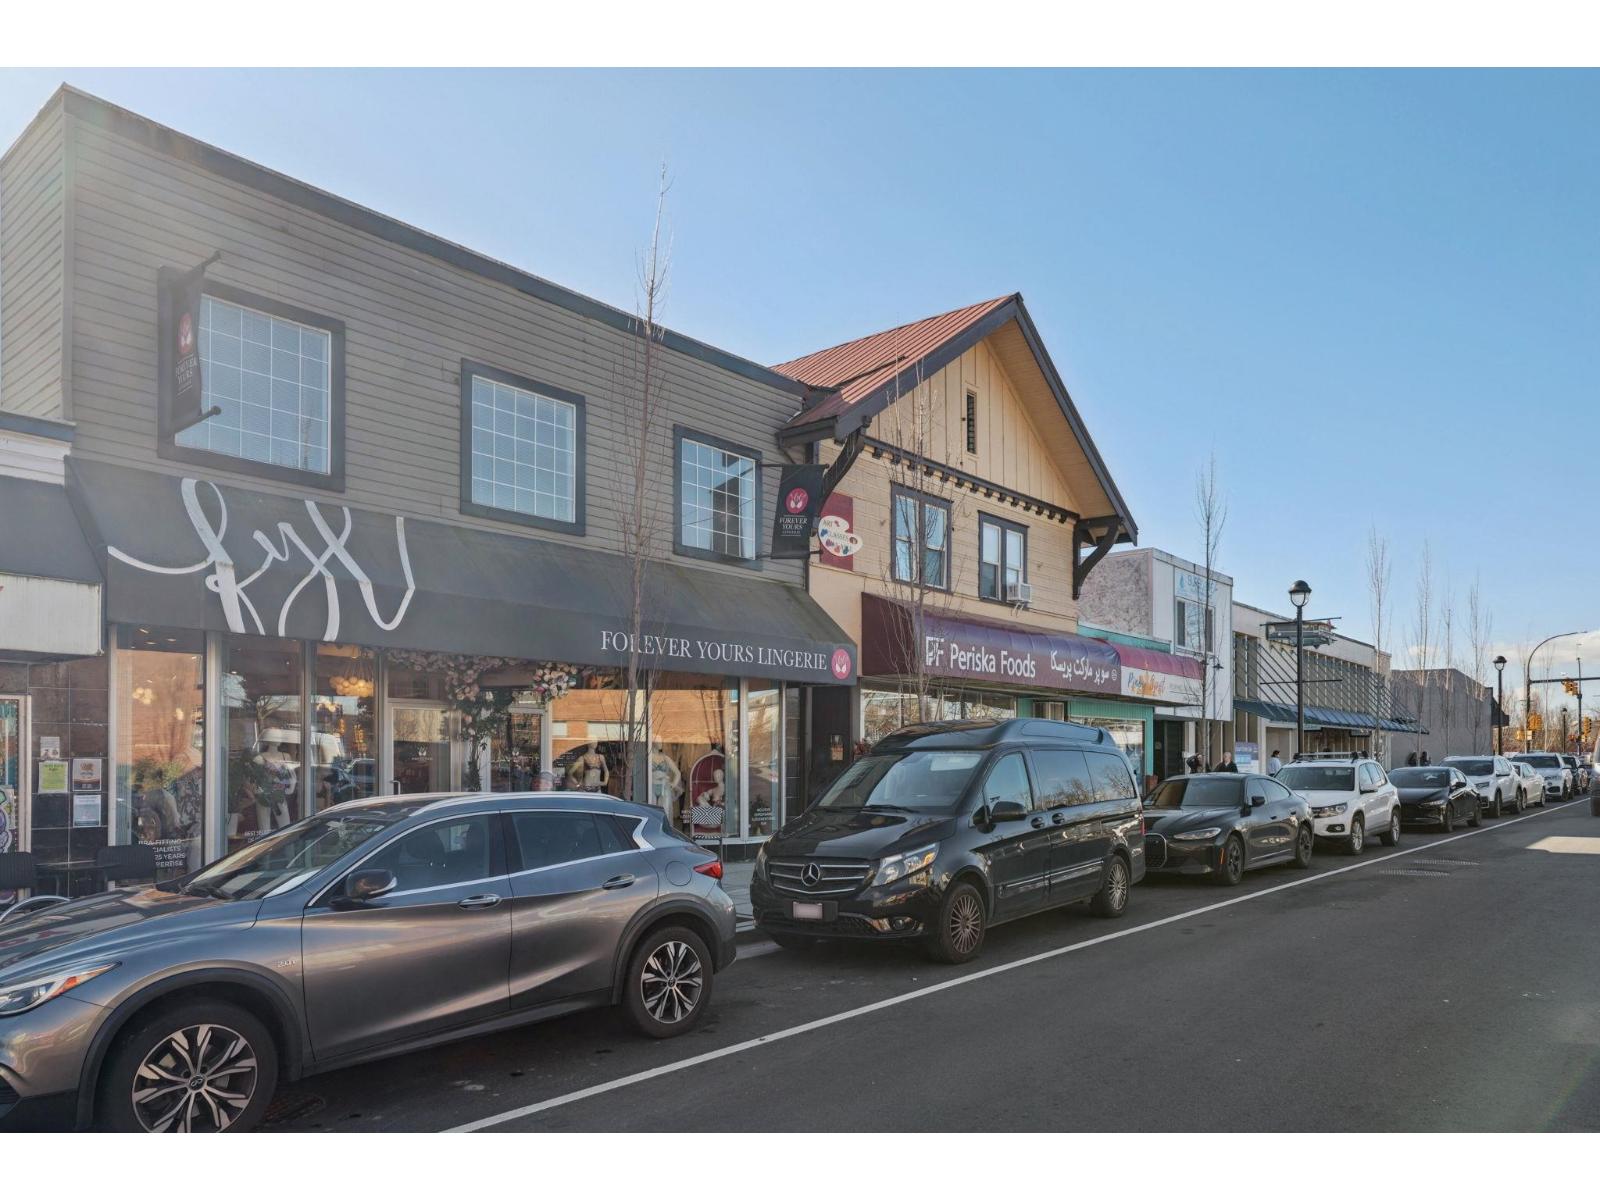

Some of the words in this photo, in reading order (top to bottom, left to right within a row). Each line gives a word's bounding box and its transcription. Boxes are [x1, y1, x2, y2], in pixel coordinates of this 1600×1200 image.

[601, 630, 692, 658] FOREVER
[696, 641, 754, 663] YOURS
[757, 647, 828, 670] LINGERIE
[950, 643, 996, 673] Periska
[1000, 650, 1036, 678] Foods
